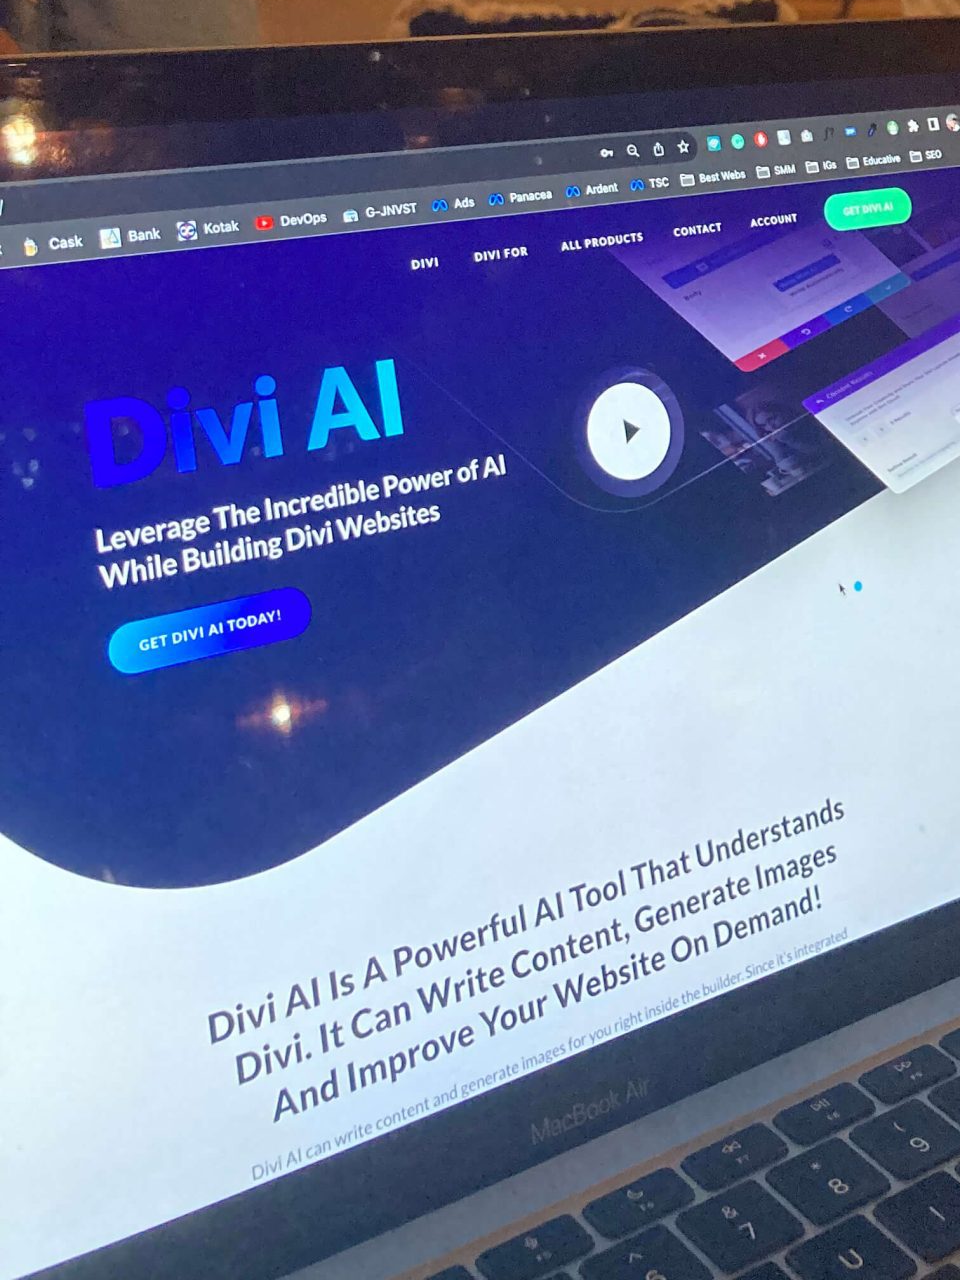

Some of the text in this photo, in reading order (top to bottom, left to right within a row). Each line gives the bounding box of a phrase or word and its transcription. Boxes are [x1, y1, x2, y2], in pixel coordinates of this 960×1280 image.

[863, 153, 901, 166] Educative
[925, 149, 943, 160] SEO
[699, 168, 746, 184] Best Webs
[774, 163, 796, 175] SMM
[586, 181, 619, 195] Ardent
[649, 176, 670, 189] TSC
[454, 197, 475, 210] Ads
[509, 189, 552, 203] Panacea
[365, 203, 417, 219] G-JNVST
[842, 204, 860, 217] GET
[861, 202, 879, 215] DIVI
[204, 220, 240, 235] Kotak
[280, 212, 327, 228] DevOps
[750, 213, 798, 227] ACCOUNT
[128, 228, 161, 242] Bank
[673, 222, 722, 237] CONTACT
[49, 235, 83, 250] Cask
[561, 232, 644, 252] ALL PRODUCTS
[474, 246, 528, 263] DIVI FOR
[411, 257, 438, 271] DIVI
[84, 358, 404, 489] Divi AI
[94, 454, 507, 553] Leverage The Incredible Power of AI
[97, 503, 441, 589] While Building Divi Websites
[138, 608, 281, 652] GET DIVI AI TODAY!
[206, 797, 846, 1045] Divi AI Is A Powerful AI Tool That Understands
[235, 843, 838, 1086] Divi. It Can Write Content, Generate Images
[272, 884, 822, 1123] And Improve Your Website On Demand!
[250, 927, 849, 1181] Divi AI can write content and generate images for you right inside the builder. Since it's integrated
[530, 1078, 649, 1145] MacBook Air
[909, 1137, 929, 1152] 9
[828, 1178, 848, 1194] 8
[740, 1222, 756, 1239] 7
[838, 1248, 863, 1269] U
